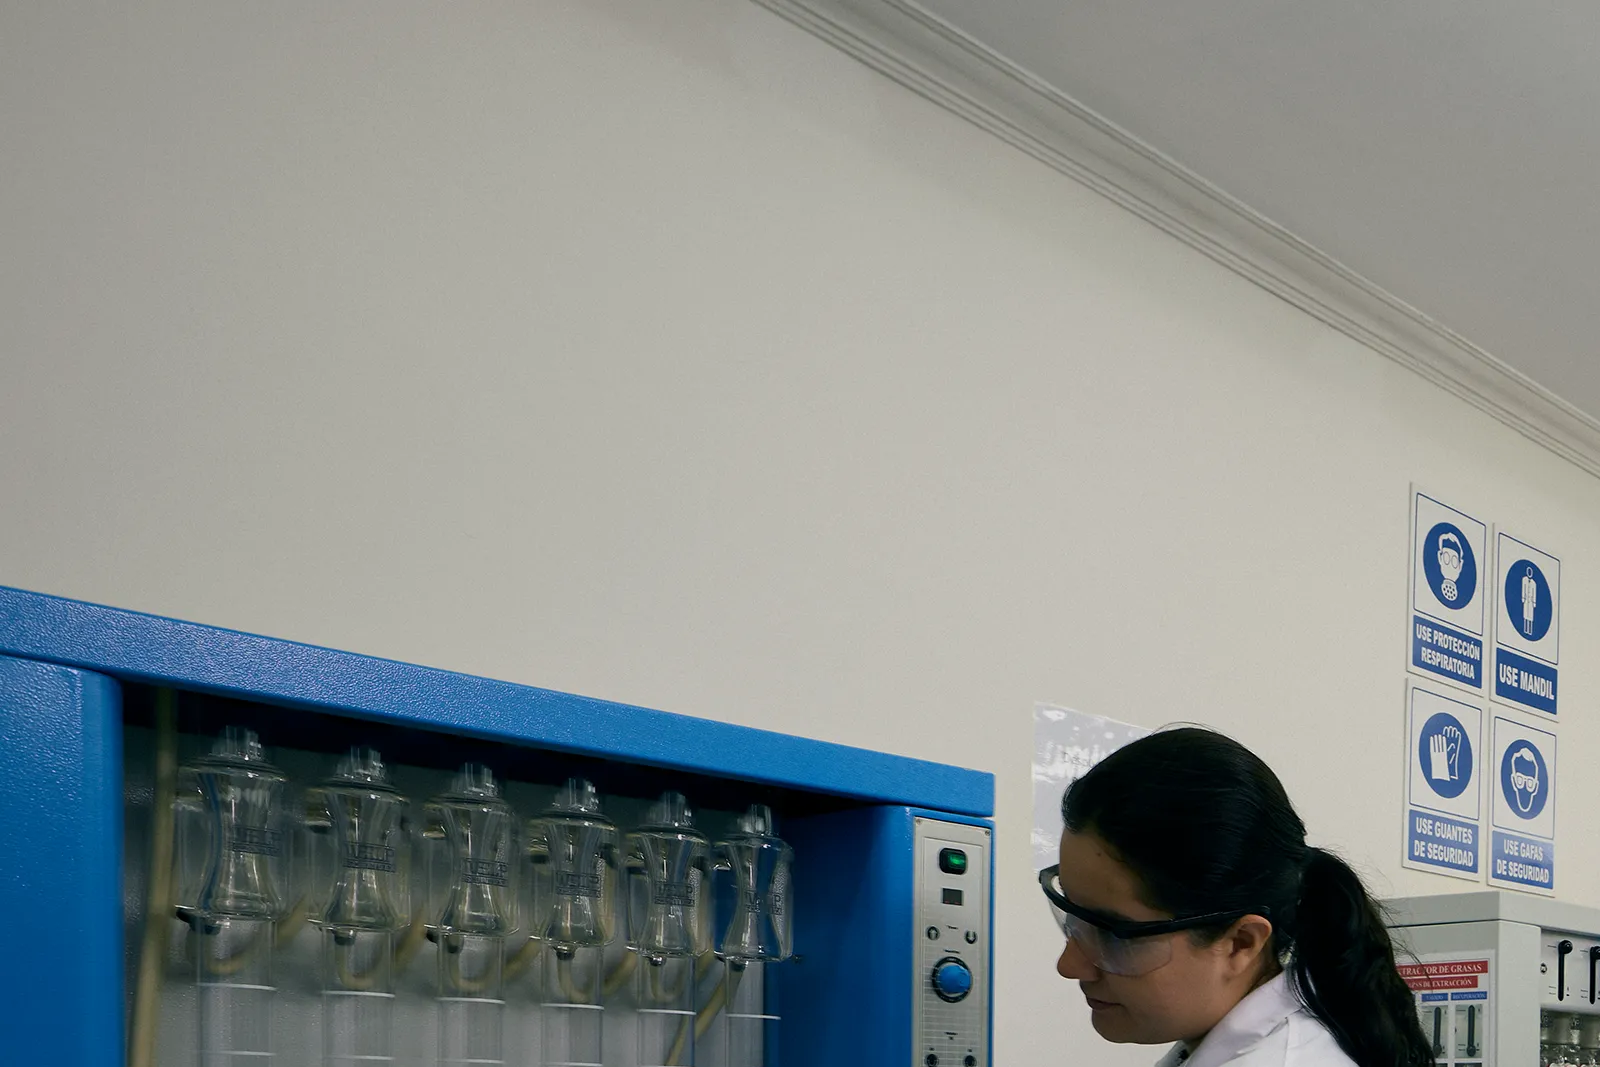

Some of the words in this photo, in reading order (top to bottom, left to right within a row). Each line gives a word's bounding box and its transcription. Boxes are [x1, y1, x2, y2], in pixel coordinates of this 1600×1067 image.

[1416, 623, 1432, 643] USE
[1433, 630, 1480, 661] PROTECCIÓN
[1421, 646, 1475, 680] RESPIRATORIA
[1499, 663, 1518, 688] USE
[1520, 670, 1555, 700] MANDIL
[1416, 817, 1433, 836] USE
[1434, 821, 1473, 845] GUANTES
[1414, 840, 1426, 858] DE
[1427, 842, 1474, 867] SEGURIDAD
[1503, 838, 1519, 857] USE
[1520, 842, 1544, 862] GAFAS
[1496, 858, 1507, 876] DE
[1508, 861, 1550, 884] SEGURIDAD
[1450, 963, 1482, 973] GRASAS
[1432, 978, 1472, 987] EXTRACCIÓN
